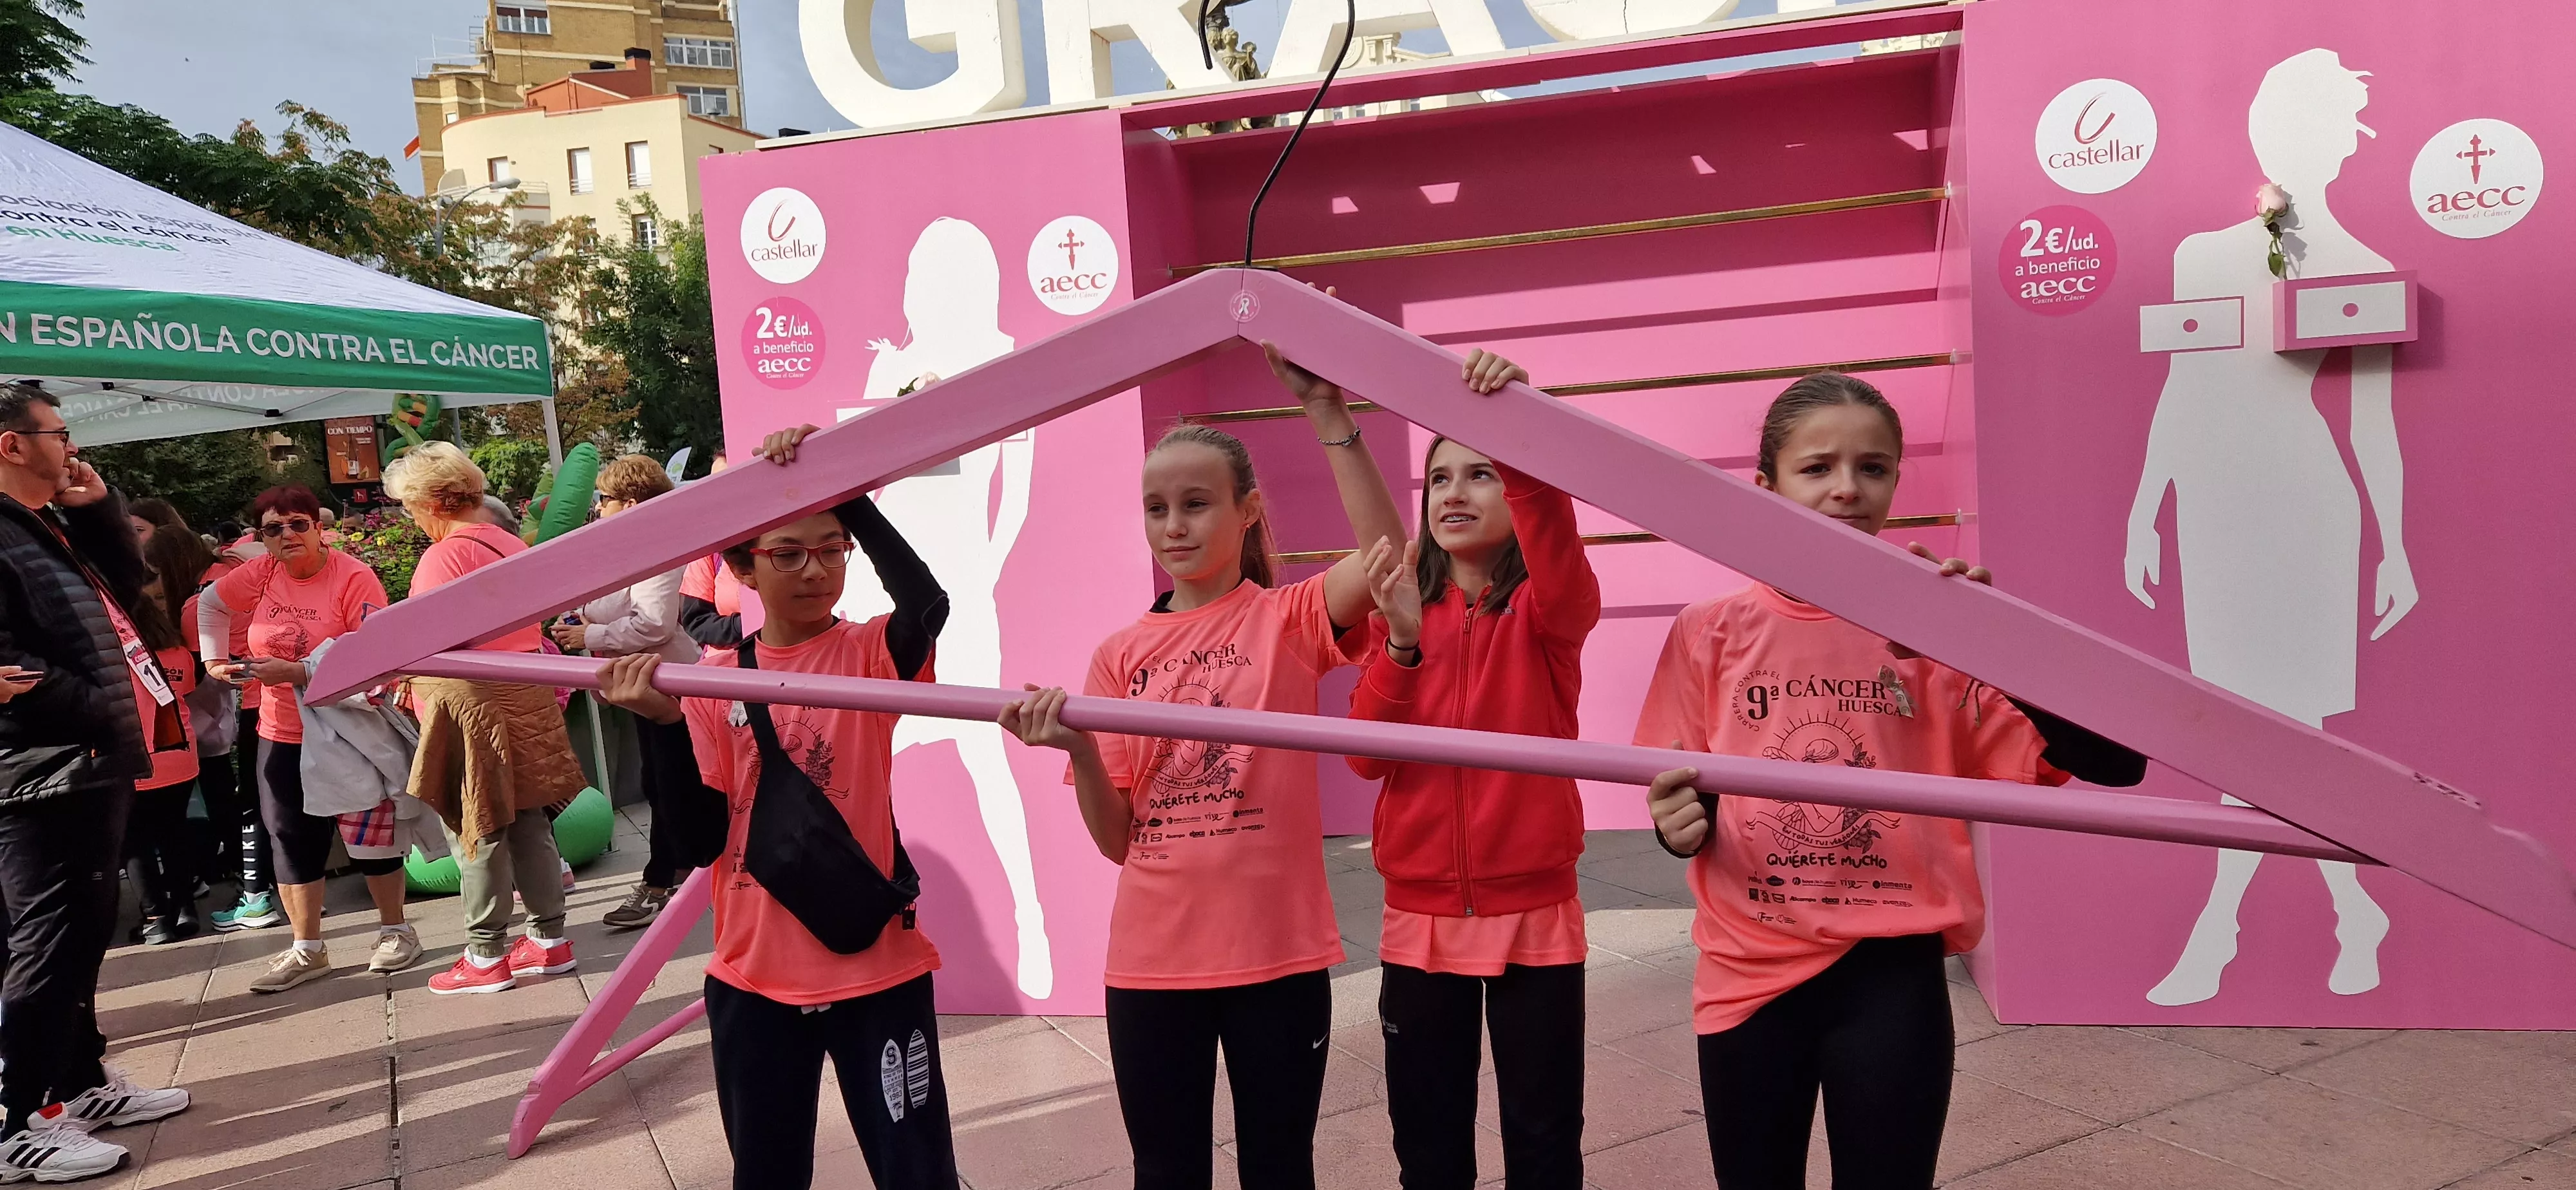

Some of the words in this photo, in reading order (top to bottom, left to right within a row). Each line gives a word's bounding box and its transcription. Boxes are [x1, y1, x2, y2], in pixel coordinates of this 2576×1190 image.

[2048, 139, 2145, 169] castellar
[2427, 185, 2526, 214] aecc
[137, 212, 267, 241] española
[2441, 213, 2469, 222] Contra
[2472, 211, 2479, 219] el
[2483, 209, 2512, 218] Cáncer
[0, 209, 94, 228] ontra
[97, 219, 129, 232] el
[131, 225, 231, 246] cáncer
[6, 224, 52, 239] en
[55, 227, 181, 252] Huesca
[751, 238, 819, 262] castellar
[2015, 265, 2024, 276] a
[2029, 256, 2101, 276] beneficio
[1040, 272, 1107, 293] aecc
[2020, 275, 2096, 299] aecc
[30, 312, 242, 354] ESPAÑOLA
[246, 327, 386, 363] CONTRA
[388, 338, 428, 365] EL
[430, 335, 542, 371] CÁNCER
[753, 345, 761, 354] a
[762, 340, 814, 354] beneficio
[757, 357, 811, 373] aecc
[327, 427, 344, 435] CON
[1202, 656, 1253, 674] HUESCA
[1734, 670, 1768, 693] CONTRA
[1770, 670, 1780, 681] EL
[1786, 674, 1887, 700] CÁNCER
[1838, 699, 1902, 717] HUESCA
[1204, 787, 1245, 803] MUCHO
[242, 824, 257, 880] NIKE
[1841, 854, 1888, 869] MUCHO
[885, 1045, 898, 1067] S
